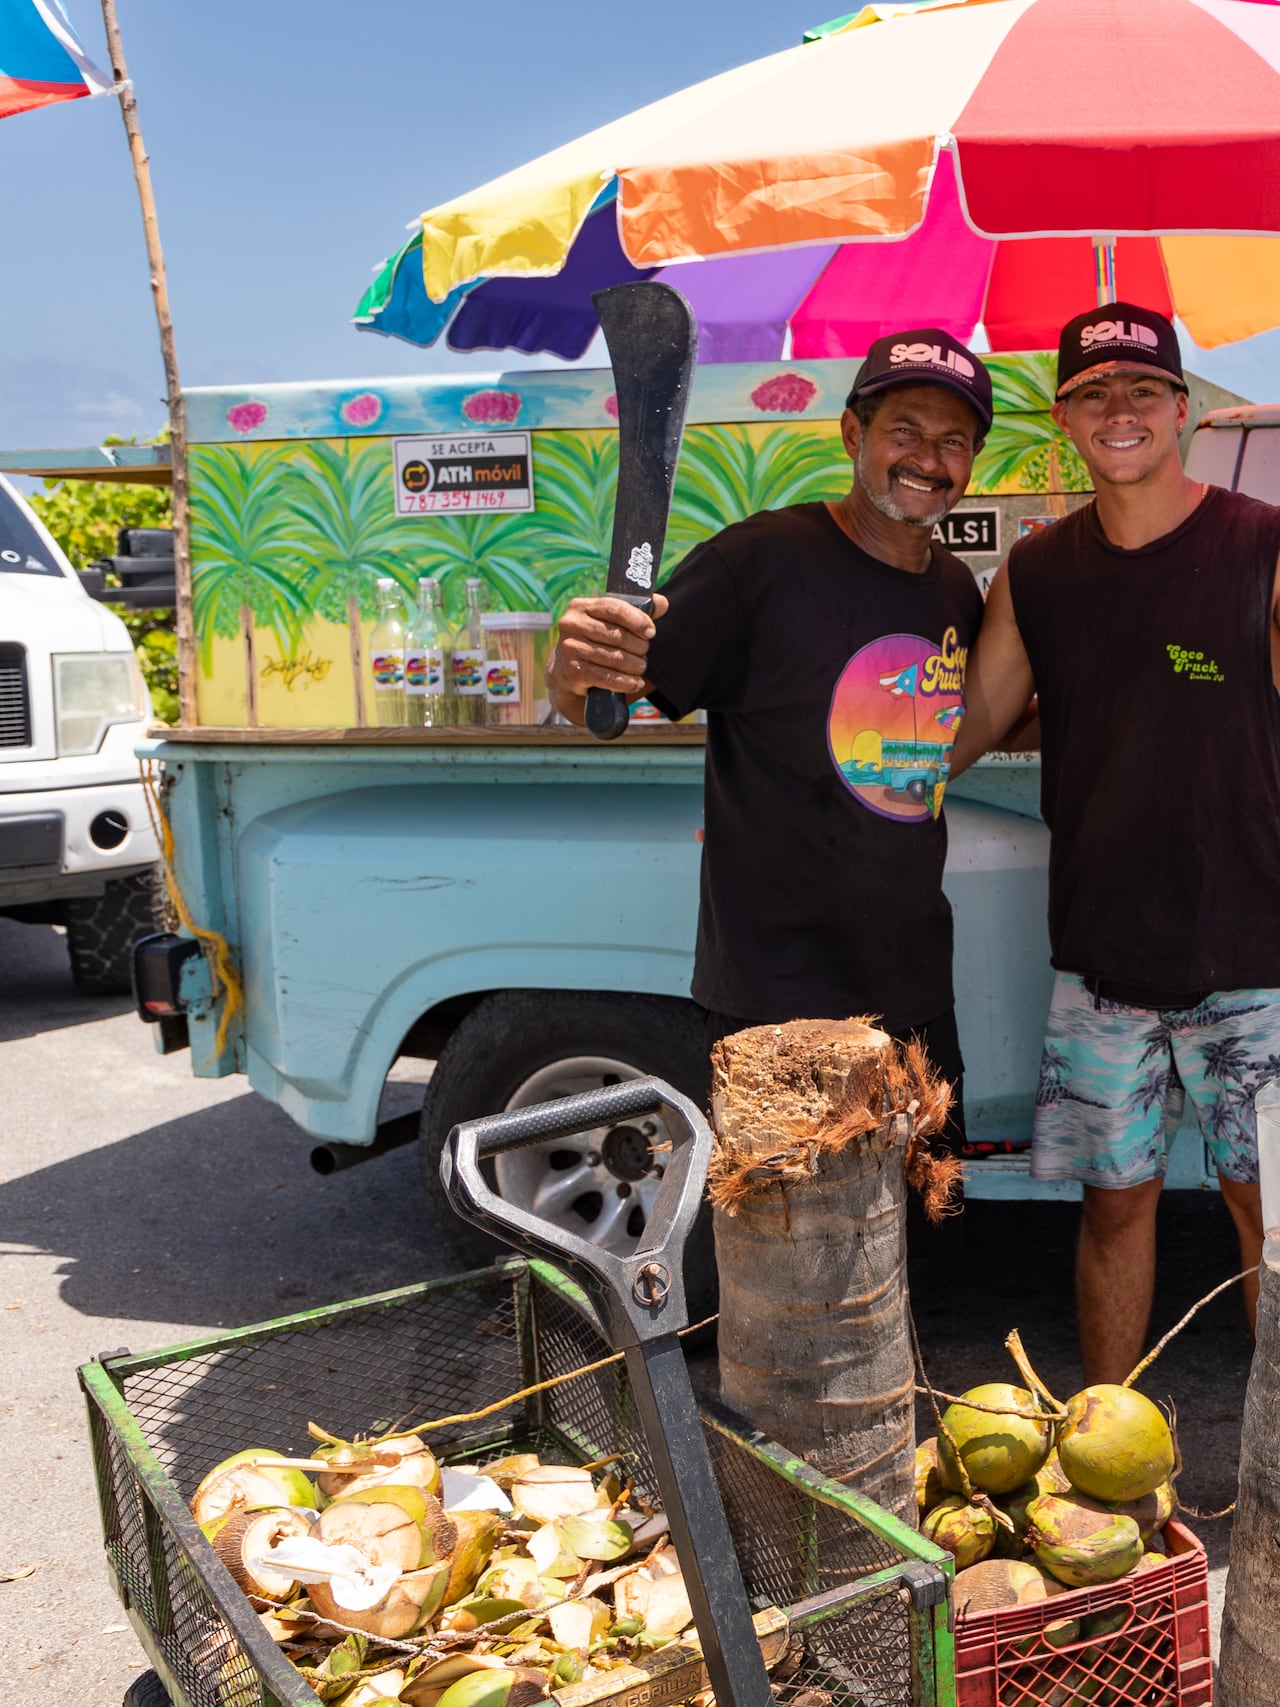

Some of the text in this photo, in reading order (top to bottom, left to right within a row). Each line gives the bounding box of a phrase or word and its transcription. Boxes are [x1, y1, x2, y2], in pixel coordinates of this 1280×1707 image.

[1080, 320, 1158, 347] SOLID
[889, 343, 976, 378] SOLID
[431, 441, 496, 455] SE ACEPTA
[437, 463, 521, 484] ATH móvil
[404, 492, 438, 512] 787
[1166, 644, 1204, 660] Coco
[1174, 658, 1219, 673] Truck
